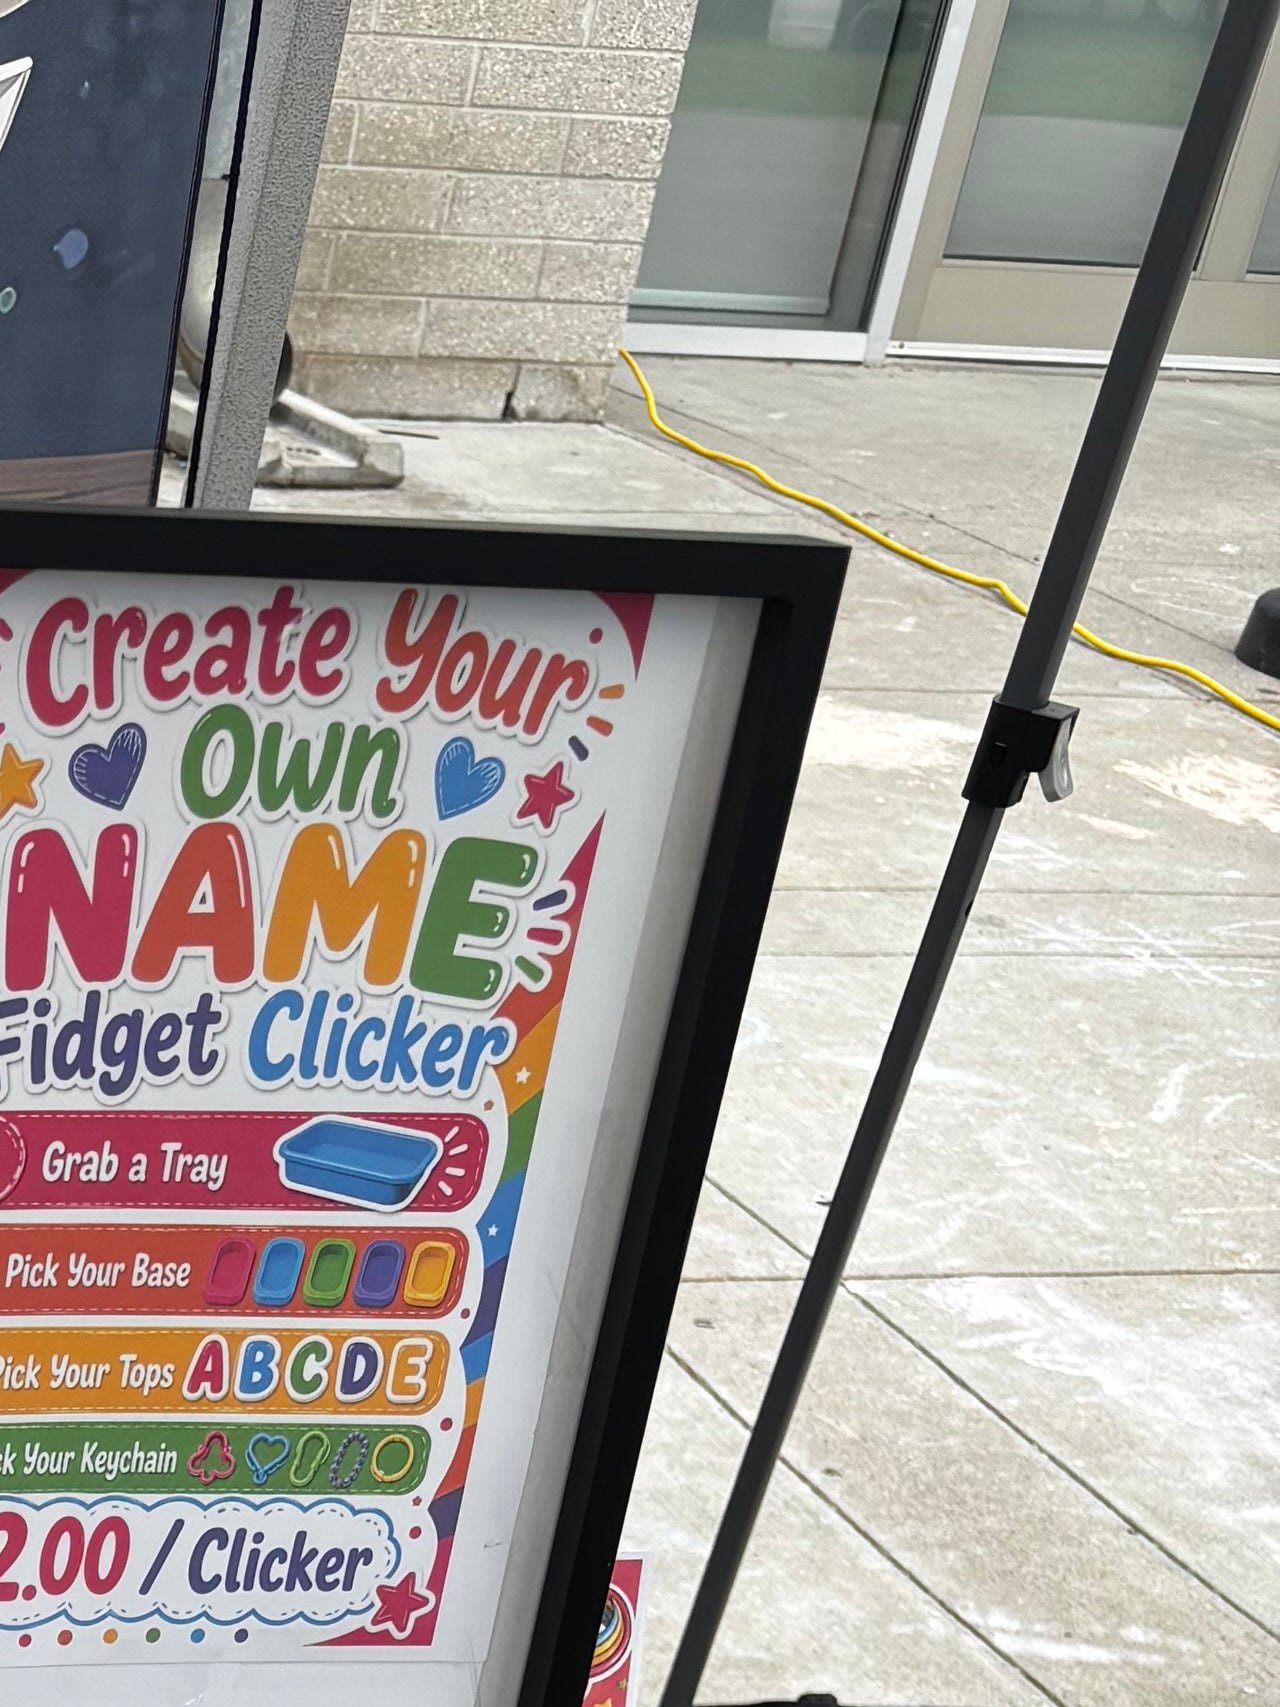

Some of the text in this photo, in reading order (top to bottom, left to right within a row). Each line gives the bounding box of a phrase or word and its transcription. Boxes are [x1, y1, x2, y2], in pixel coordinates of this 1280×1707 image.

[25, 586, 589, 737] Create Your
[180, 703, 400, 820] Own
[4, 821, 539, 1001] NAME
[246, 991, 511, 1092] Clicker
[41, 1138, 118, 1182] Grab
[127, 1151, 147, 1182] a
[158, 1143, 229, 1197] Tray
[4, 1252, 59, 1290] Pick
[63, 1253, 124, 1290] Your
[131, 1254, 192, 1290] Base
[49, 1354, 109, 1392] Your
[117, 1354, 175, 1396] Tops
[19, 1443, 74, 1479] Your
[79, 1441, 179, 1483] Keychain
[138, 1518, 185, 1595] /
[186, 1521, 373, 1593] Clicker
